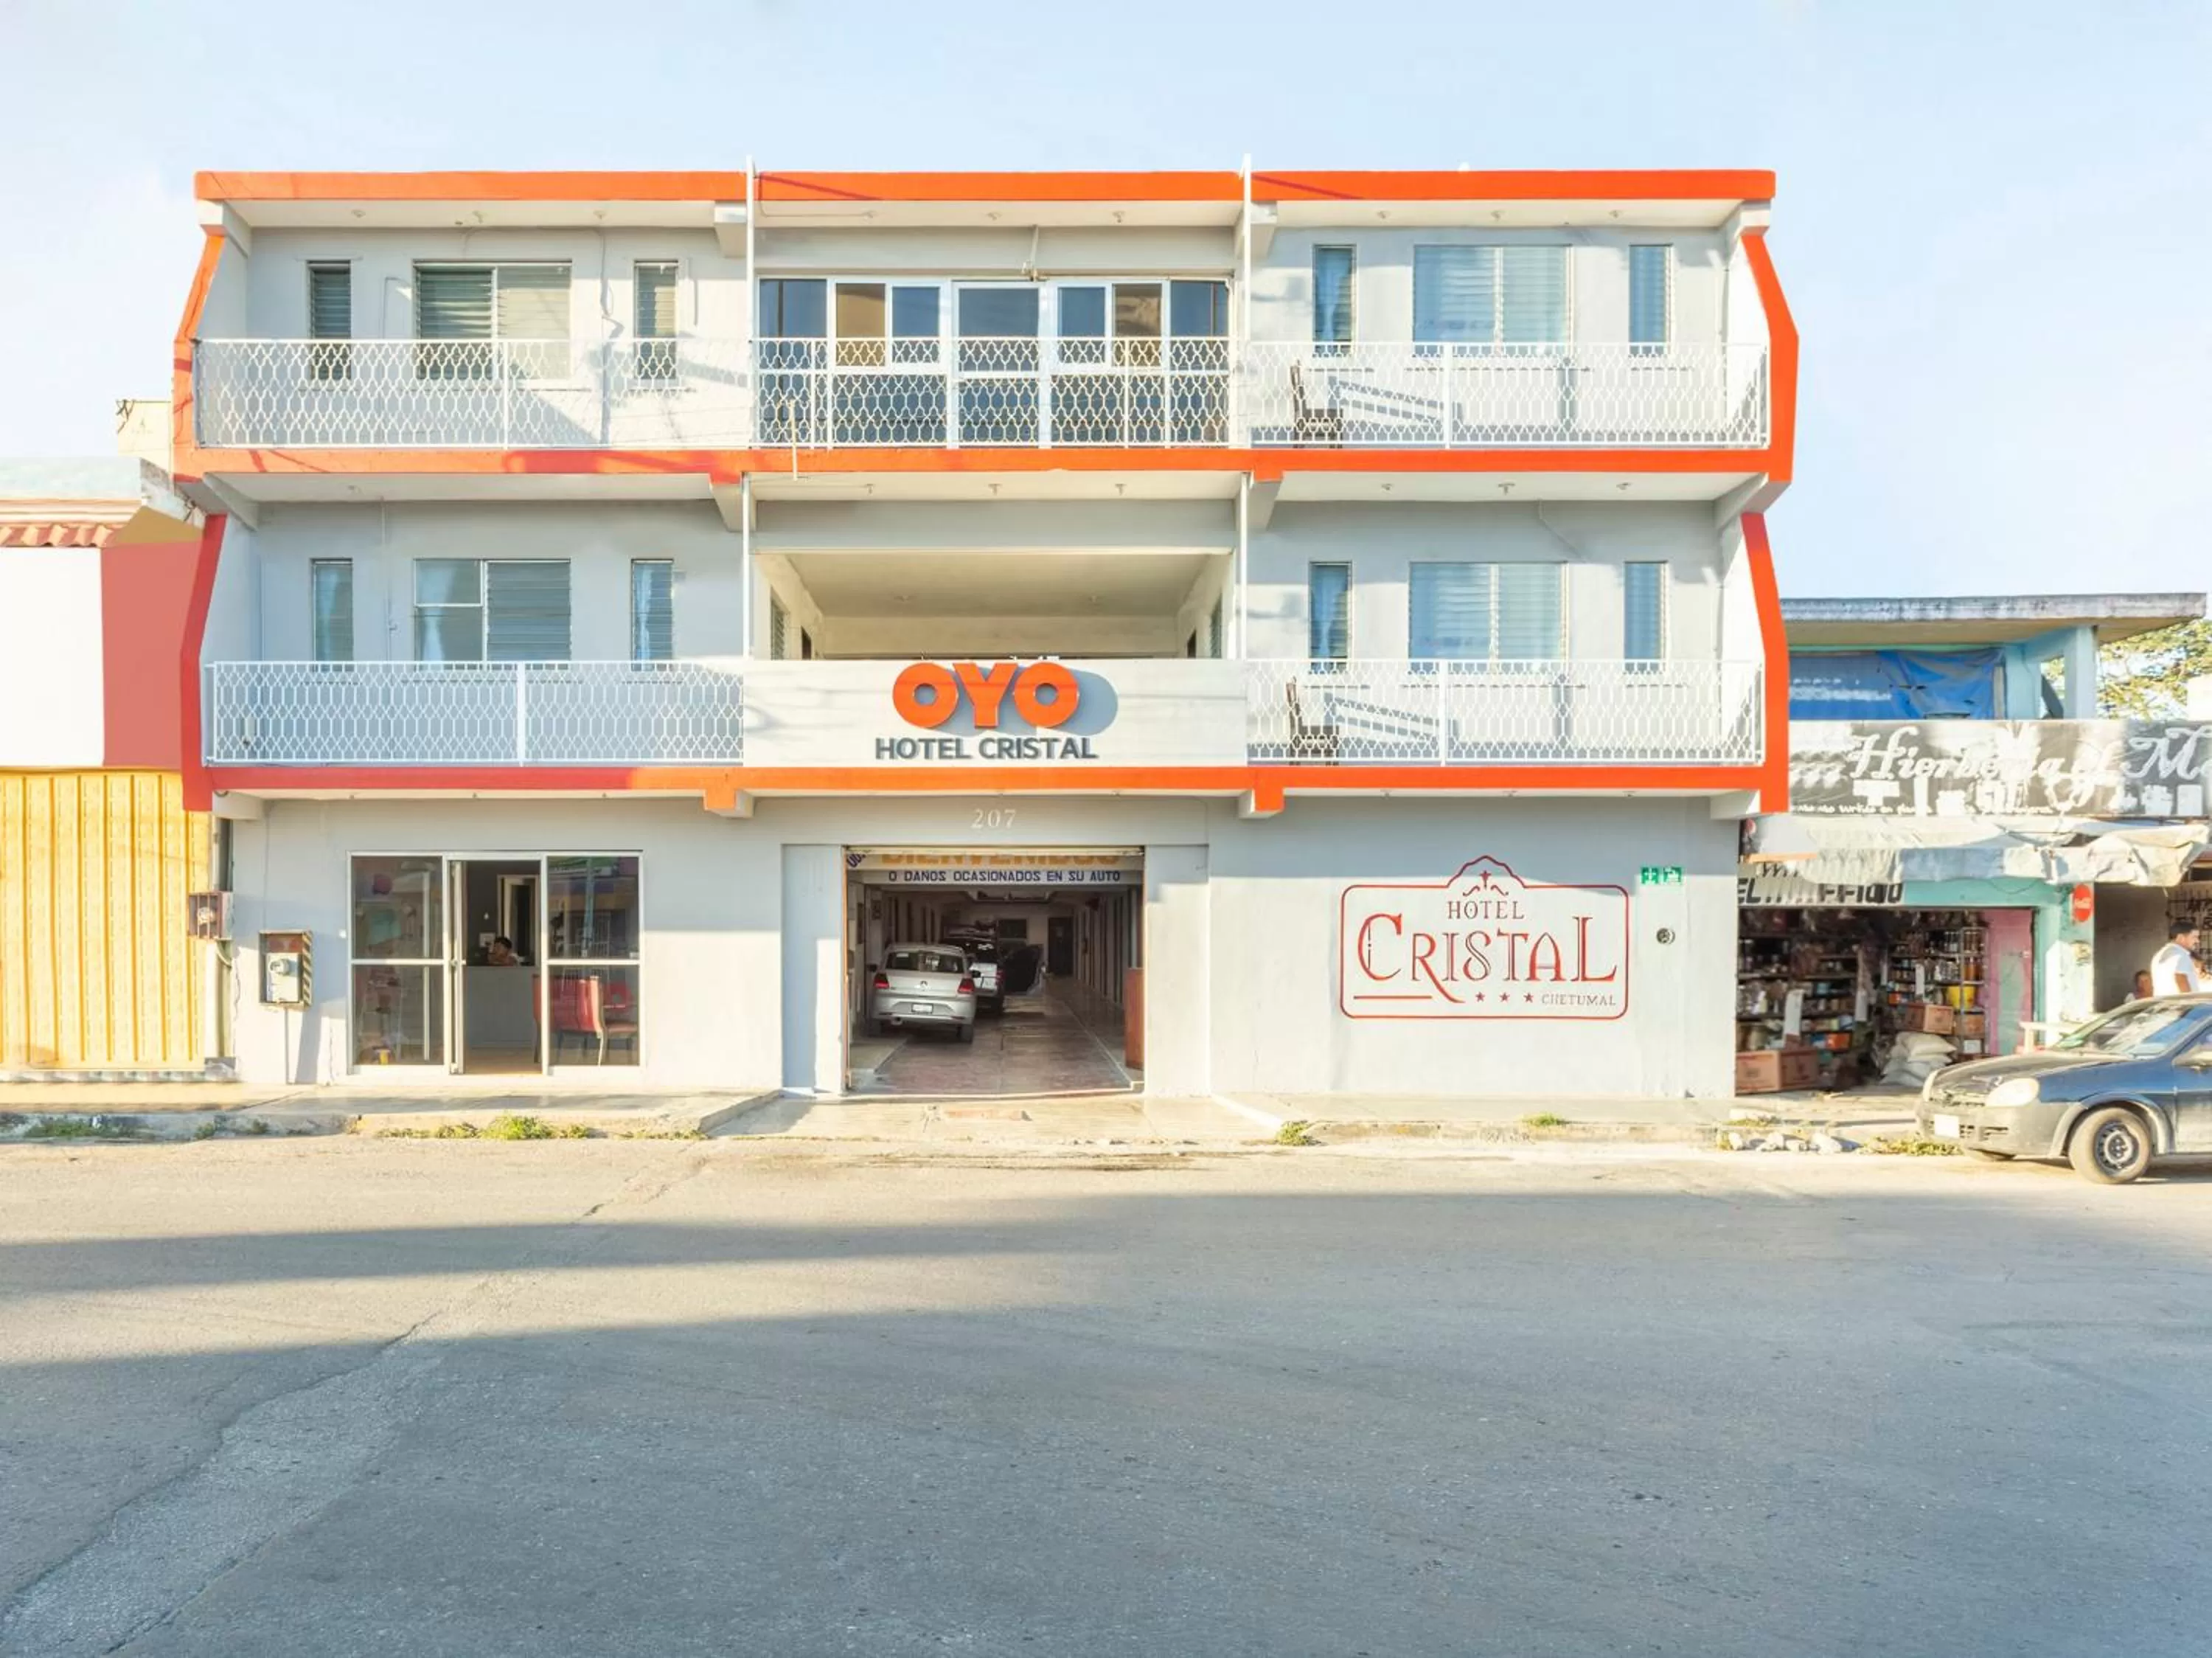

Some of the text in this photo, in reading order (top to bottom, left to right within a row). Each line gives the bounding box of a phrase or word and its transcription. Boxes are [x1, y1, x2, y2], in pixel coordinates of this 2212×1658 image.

[892, 662, 1079, 728] OYO
[875, 737, 1099, 760] HOTEL CRISTAL
[971, 808, 1017, 830] 207
[888, 870, 898, 882] O
[953, 870, 1040, 883] OCASIONADOS
[1046, 870, 1062, 882] EN
[1068, 870, 1085, 882] SU
[1089, 870, 1121, 882] AUTO
[1447, 901, 1525, 920] HOTEL
[1357, 912, 1618, 1004] CRISTAL
[1541, 993, 1616, 1007] CHETUMAL
